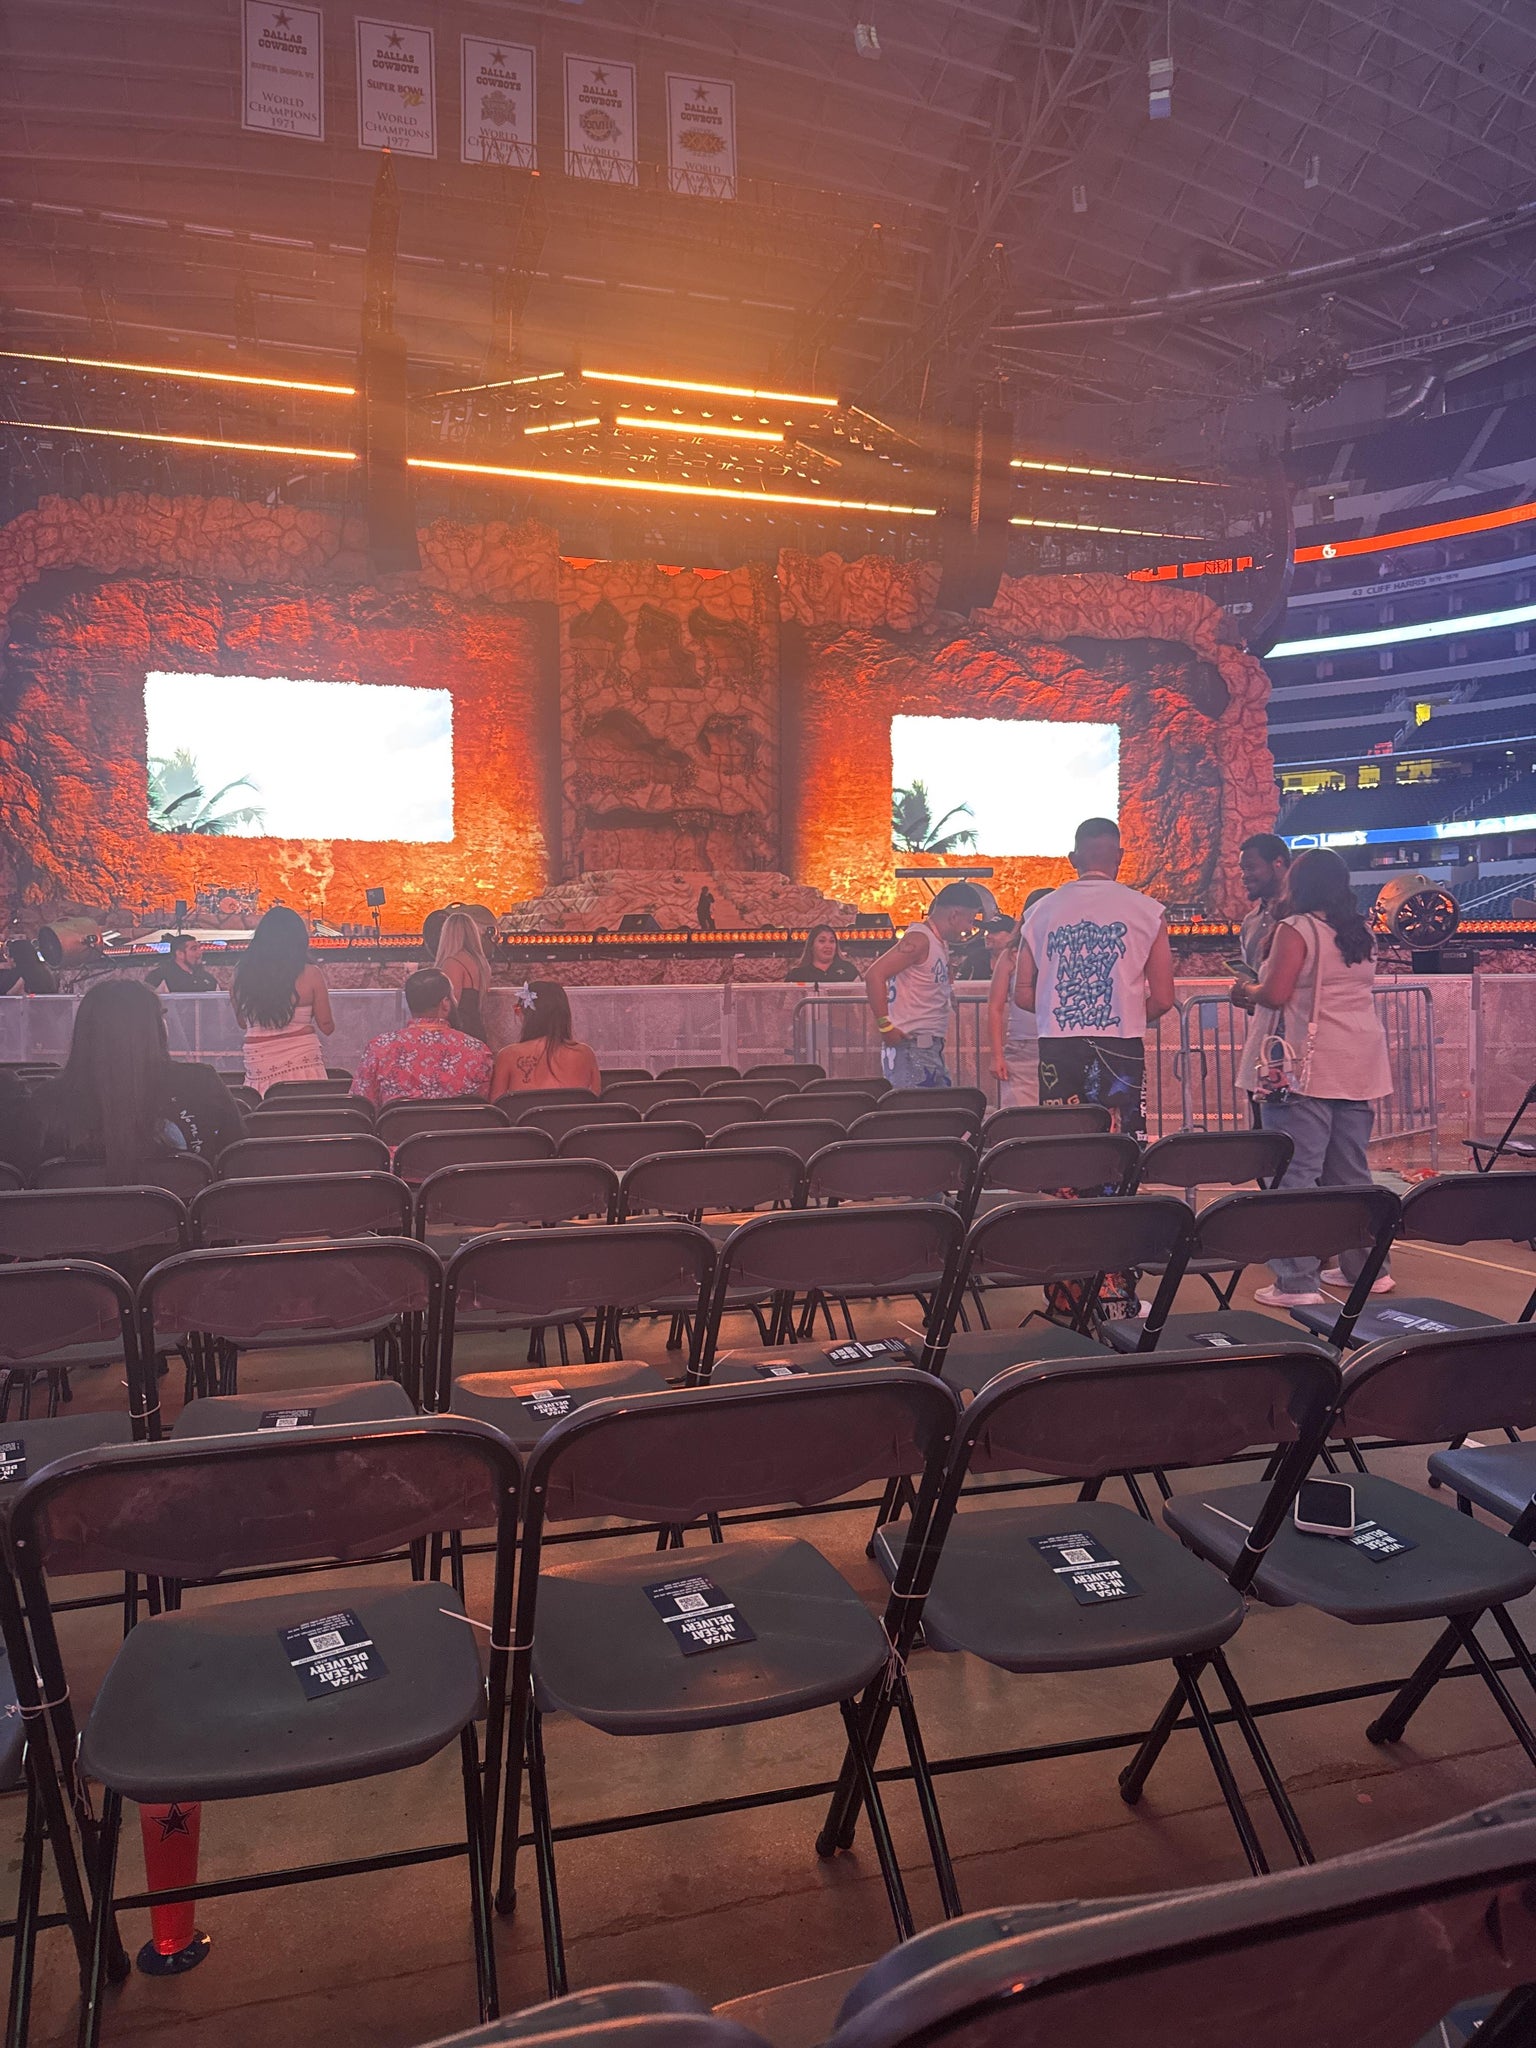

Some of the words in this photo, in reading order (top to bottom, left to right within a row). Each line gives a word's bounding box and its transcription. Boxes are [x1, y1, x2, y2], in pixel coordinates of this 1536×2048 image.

[263, 29, 303, 44] DALLAS
[258, 39, 308, 56] COWBOYS
[376, 50, 415, 63] DALLAS
[372, 60, 420, 74] COWBOYS
[481, 67, 517, 80] DALLAS
[476, 76, 522, 91] COWBOYS
[582, 85, 618, 98] DALLAS
[578, 94, 622, 108] COWBOYS
[684, 103, 719, 115] DALLAS
[272, 117, 295, 130] 1971
[681, 112, 723, 126] COWBOYS
[386, 136, 410, 148] 1977
[1366, 584, 1391, 595] CLIFF
[1393, 578, 1426, 590] HARRIS
[1046, 919, 1128, 961] MATADOR
[1057, 951, 1119, 981] NASTY
[1379, 1542, 1405, 1553] VISA
[1071, 1570, 1122, 1584] DELIVERY
[1082, 1578, 1126, 1592] IN-SEAT
[1095, 1587, 1127, 1598] VISA
[680, 1614, 735, 1633] DELIVERY
[690, 1623, 736, 1640] IN-SEAT
[703, 1633, 736, 1645] VISA
[309, 1651, 370, 1676] DELIVERY
[318, 1661, 369, 1683] IN-SEAT
[330, 1672, 367, 1687] VISA
